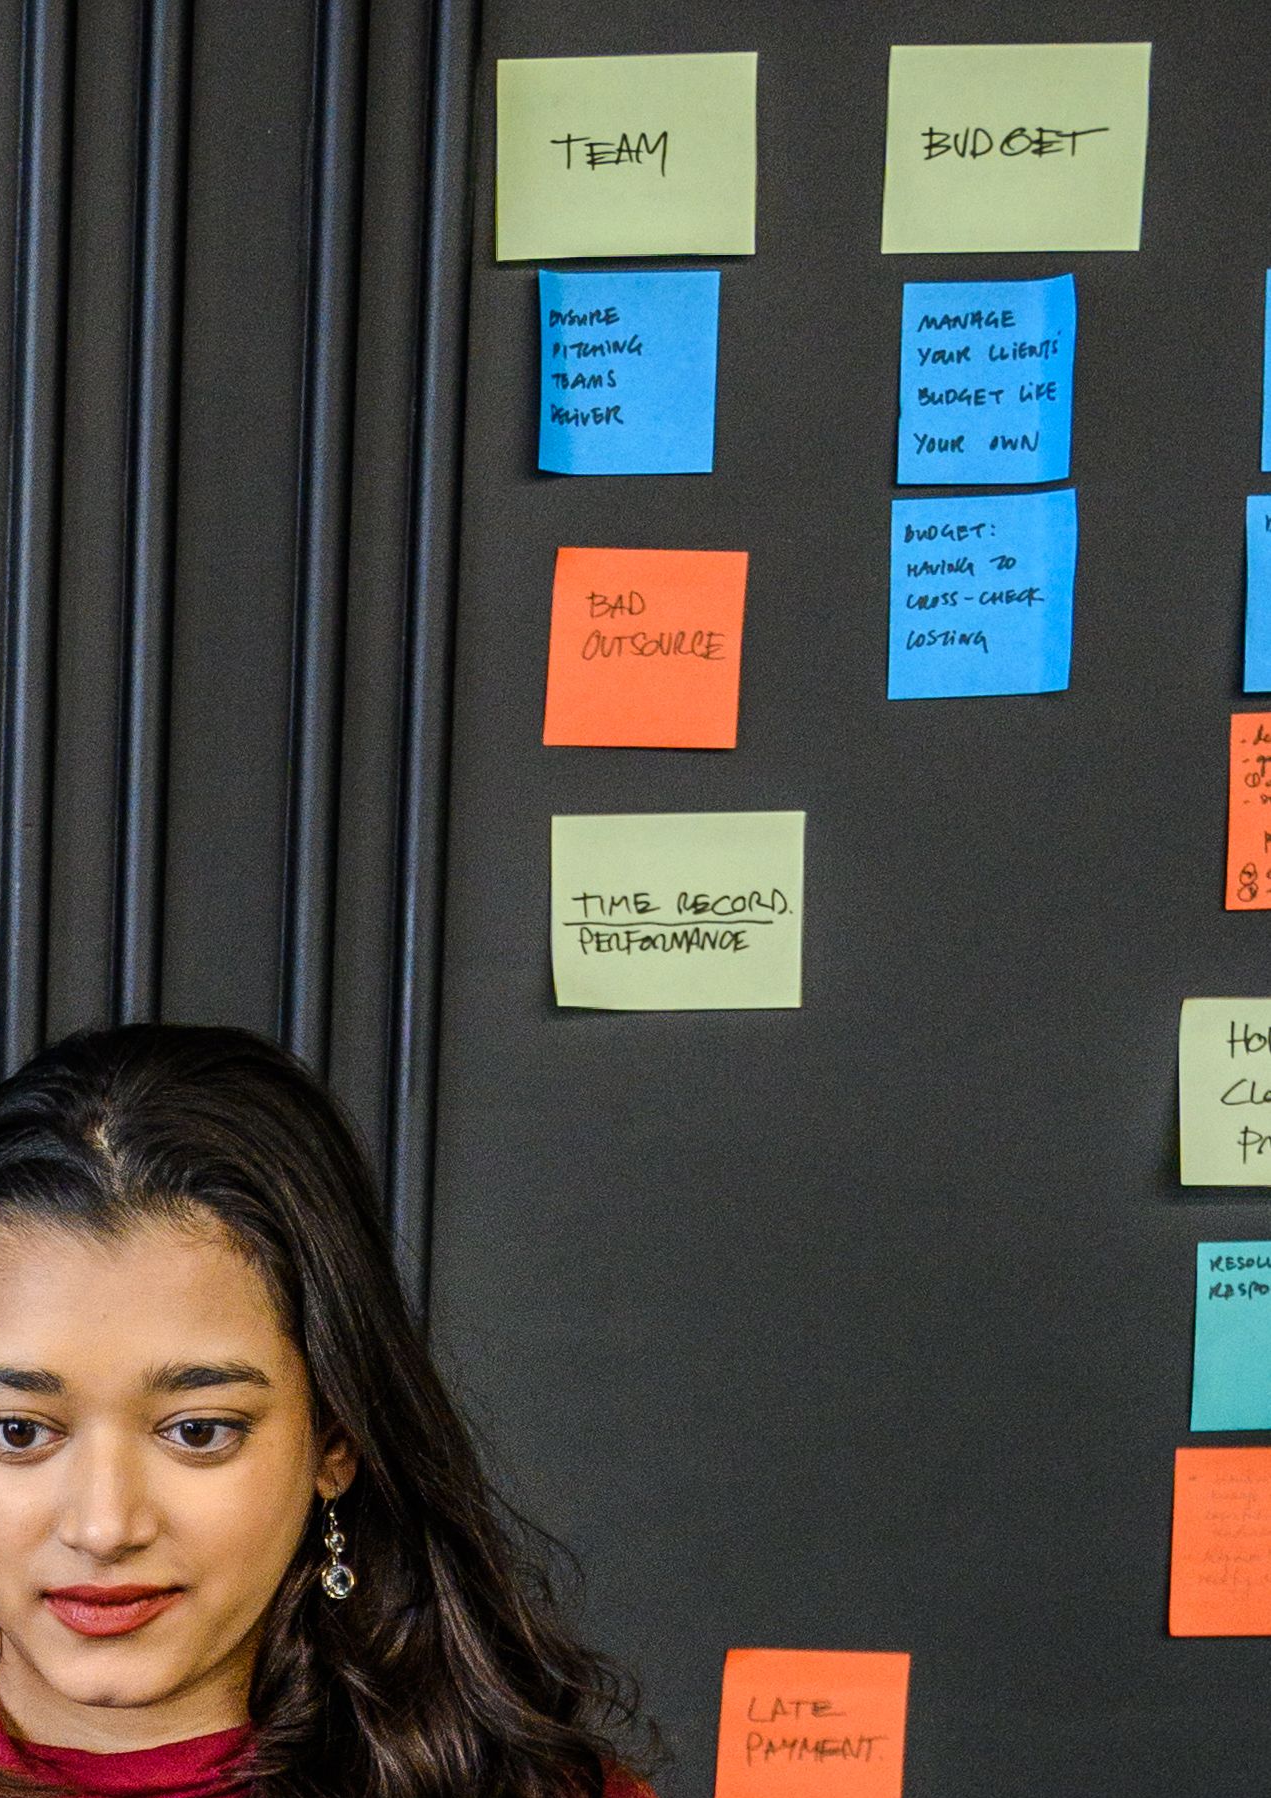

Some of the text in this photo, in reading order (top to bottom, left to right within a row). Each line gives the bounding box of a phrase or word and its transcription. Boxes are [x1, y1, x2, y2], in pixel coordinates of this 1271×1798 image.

[549, 130, 669, 178] TEAM
[920, 126, 1111, 160] BUDGET
[917, 310, 1016, 333] MANAGE
[551, 334, 643, 360] PITCHING
[917, 346, 971, 367] YOUR
[550, 372, 617, 391] TEAMS
[917, 387, 1005, 406] BUDGET
[548, 402, 624, 427] DELIVER
[913, 431, 1040, 454] YOUR OWN
[907, 555, 1016, 577] HAVING TO
[585, 590, 646, 618] BAD
[581, 628, 727, 661] OUTSOURCE
[906, 629, 988, 653] COSTING
[571, 891, 661, 917] TIME
[578, 926, 750, 956] PERFORMANCE
[747, 1697, 848, 1723] LATE
